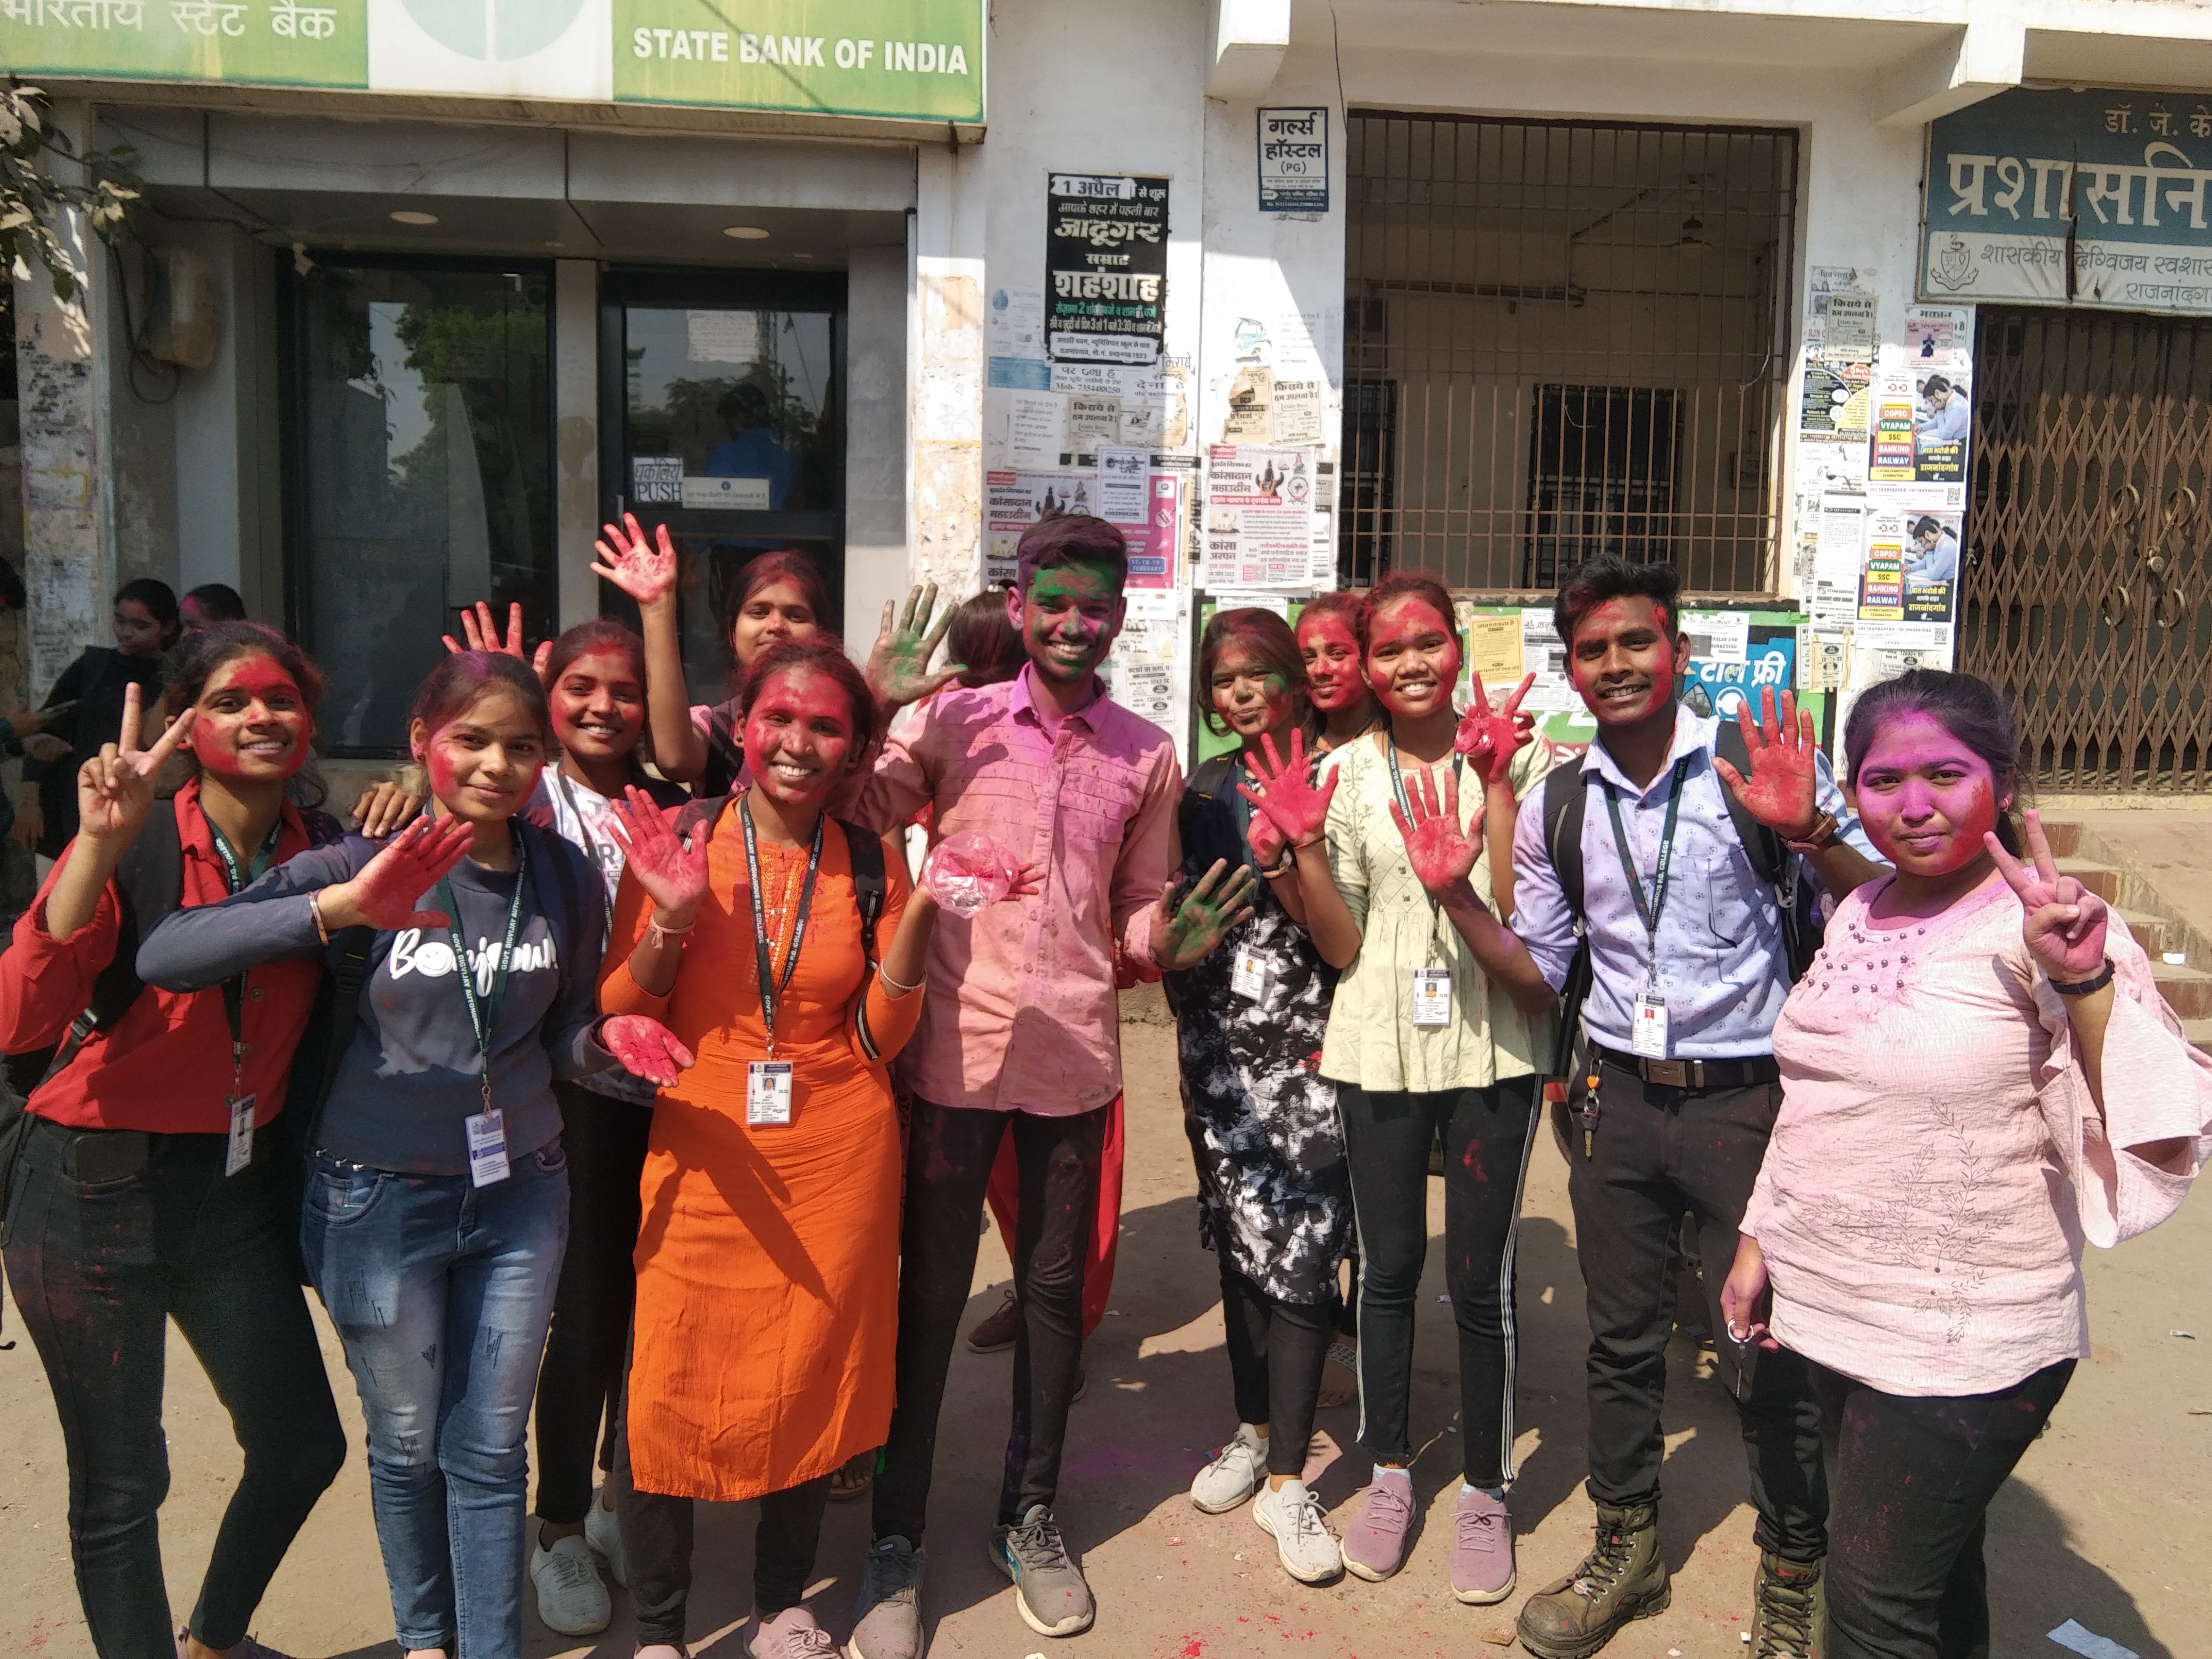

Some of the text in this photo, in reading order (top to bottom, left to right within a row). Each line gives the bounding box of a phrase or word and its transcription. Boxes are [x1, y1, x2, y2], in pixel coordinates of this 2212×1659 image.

[633, 27, 969, 76] STATE BANK OF INDIA
[1264, 138, 1322, 160] हॉस्टल
[1280, 161, 1306, 174] (PG)
[1063, 180, 1070, 194] 1
[1947, 140, 2212, 229] प्रशासनि
[1058, 200, 1087, 214] आपके
[1088, 204, 1108, 215] शहर
[1109, 201, 1118, 215] में
[1119, 202, 1143, 216] पहली
[1053, 217, 1162, 248] जादूगर
[1085, 253, 1131, 266] सम्राट
[1981, 241, 2063, 267] शासकीय
[1052, 266, 1162, 302] शहंशाह
[2126, 278, 2212, 305] राजनांदगा
[1074, 402, 1104, 412] किराये
[1881, 422, 1911, 430] VYAPAM
[1878, 445, 1910, 453] BANKING
[1878, 456, 1910, 465] RAILWAY
[638, 482, 682, 502] PUSH
[1870, 562, 1900, 571] VYAPAM
[1867, 584, 1899, 593] BANKING
[1867, 596, 1898, 605] RAILWAY
[1750, 650, 1787, 689] फ्री
[1659, 839, 1670, 870] COLLEGE
[505, 917, 517, 949] DIGVIJAY
[456, 954, 471, 988] DIGVIJAY
